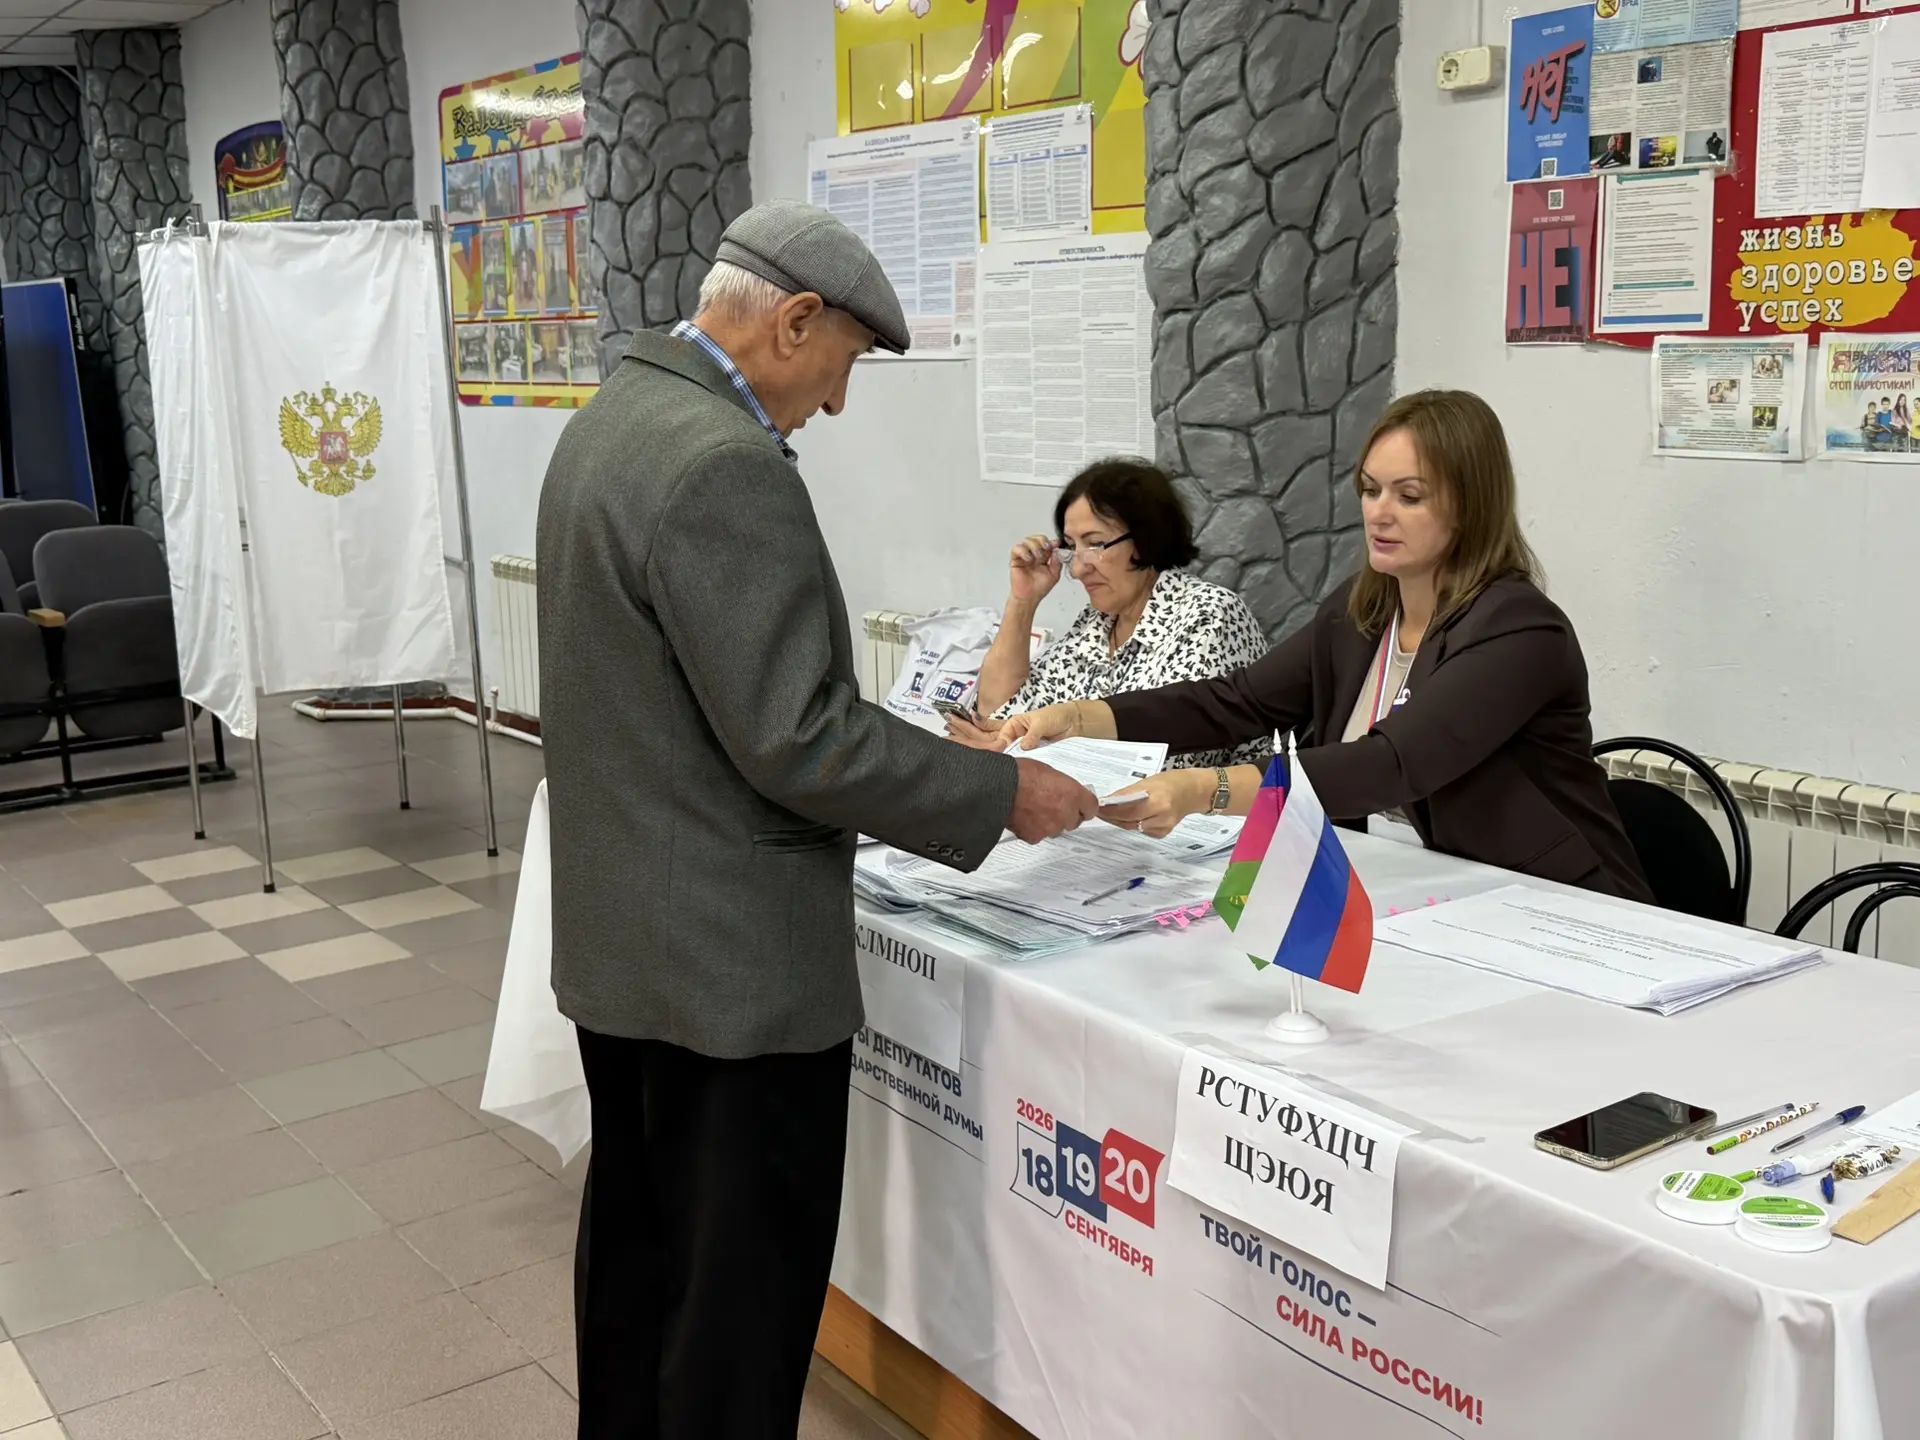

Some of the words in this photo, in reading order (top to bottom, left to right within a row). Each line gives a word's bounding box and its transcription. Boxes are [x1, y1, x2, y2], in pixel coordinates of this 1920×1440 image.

[1739, 224, 1845, 252] жизнь
[1740, 257, 1914, 294] здоровье
[1738, 298, 1844, 332] успех
[935, 686, 947, 698] 18
[949, 684, 962, 698] 19
[872, 1032, 962, 1097] ДЕПУТАТОВ
[943, 1104, 984, 1141] ДУМЫ
[1017, 1098, 1054, 1131] 2026
[1196, 1066, 1378, 1173] РСТУФХЦЧ
[1022, 1147, 1055, 1197] 18
[1061, 1146, 1096, 1197] 19
[1104, 1147, 1150, 1204] 20
[1223, 1135, 1336, 1215] ЩЭЮЯ
[1065, 1209, 1153, 1277] СЕНТЯБРЯ
[1200, 1213, 1263, 1268] ТВОЙ
[1269, 1250, 1351, 1318] ГОЛОС
[1276, 1294, 1345, 1355] СИЛА
[1351, 1336, 1483, 1426] РОССИИ!
